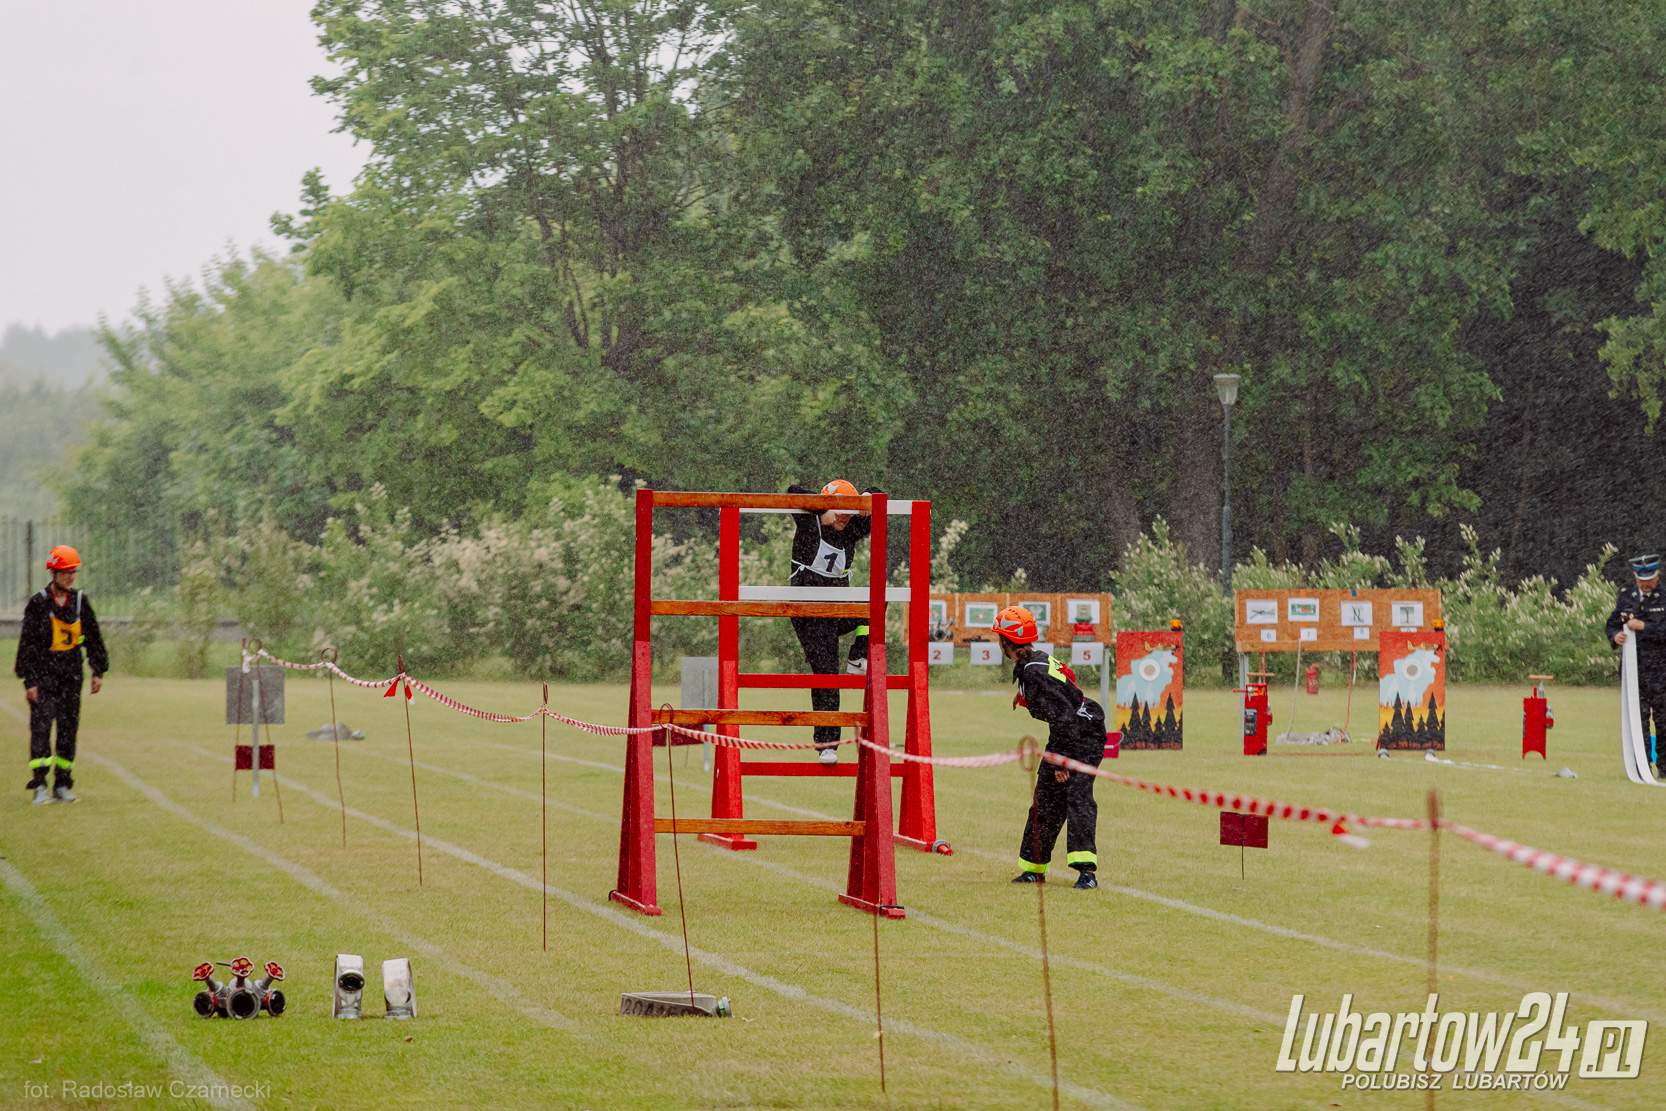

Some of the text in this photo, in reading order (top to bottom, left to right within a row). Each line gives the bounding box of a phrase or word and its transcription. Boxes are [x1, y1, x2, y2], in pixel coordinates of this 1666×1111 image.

[933, 650, 941, 660] 2
[982, 650, 990, 660] 3
[1083, 650, 1091, 660] 5
